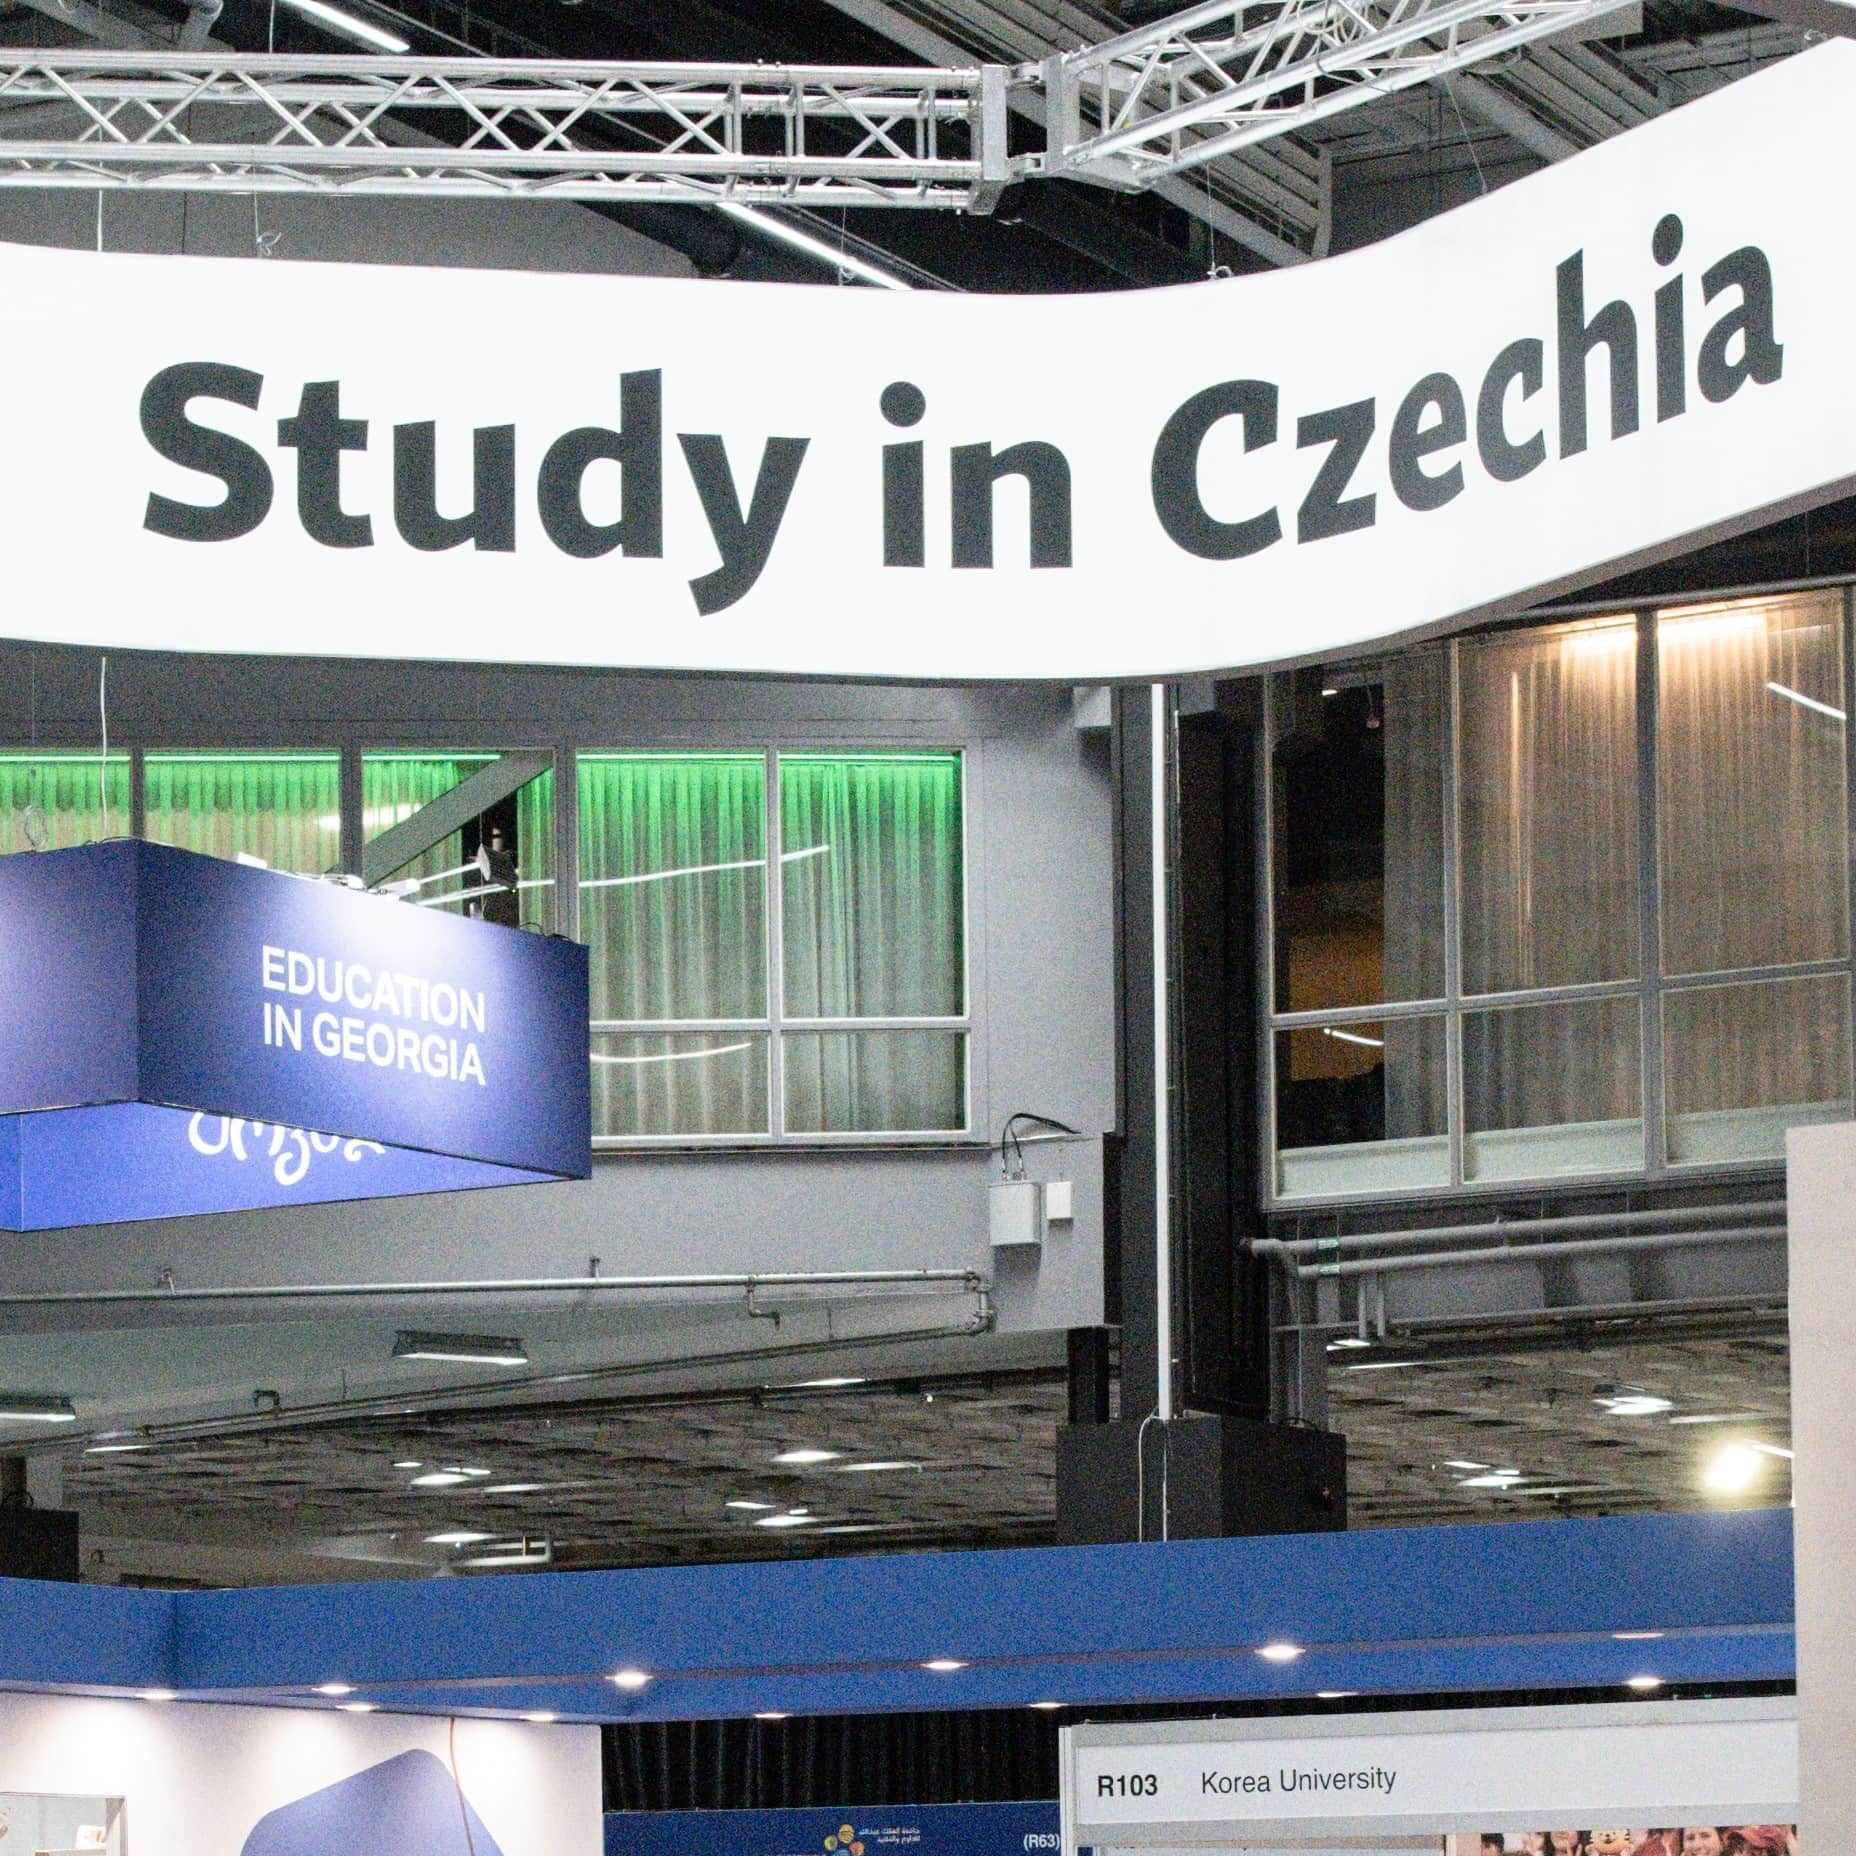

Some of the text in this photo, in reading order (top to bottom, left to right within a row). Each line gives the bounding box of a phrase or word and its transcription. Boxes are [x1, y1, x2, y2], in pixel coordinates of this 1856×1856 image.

[140, 212, 1784, 617] Study in Czechia
[262, 944, 486, 1033] EDUCATION
[263, 1002, 486, 1086] IN GEORGIA
[1097, 1764, 1397, 1798] R103 Korea University
[1023, 1833, 1061, 1851] (R63)
